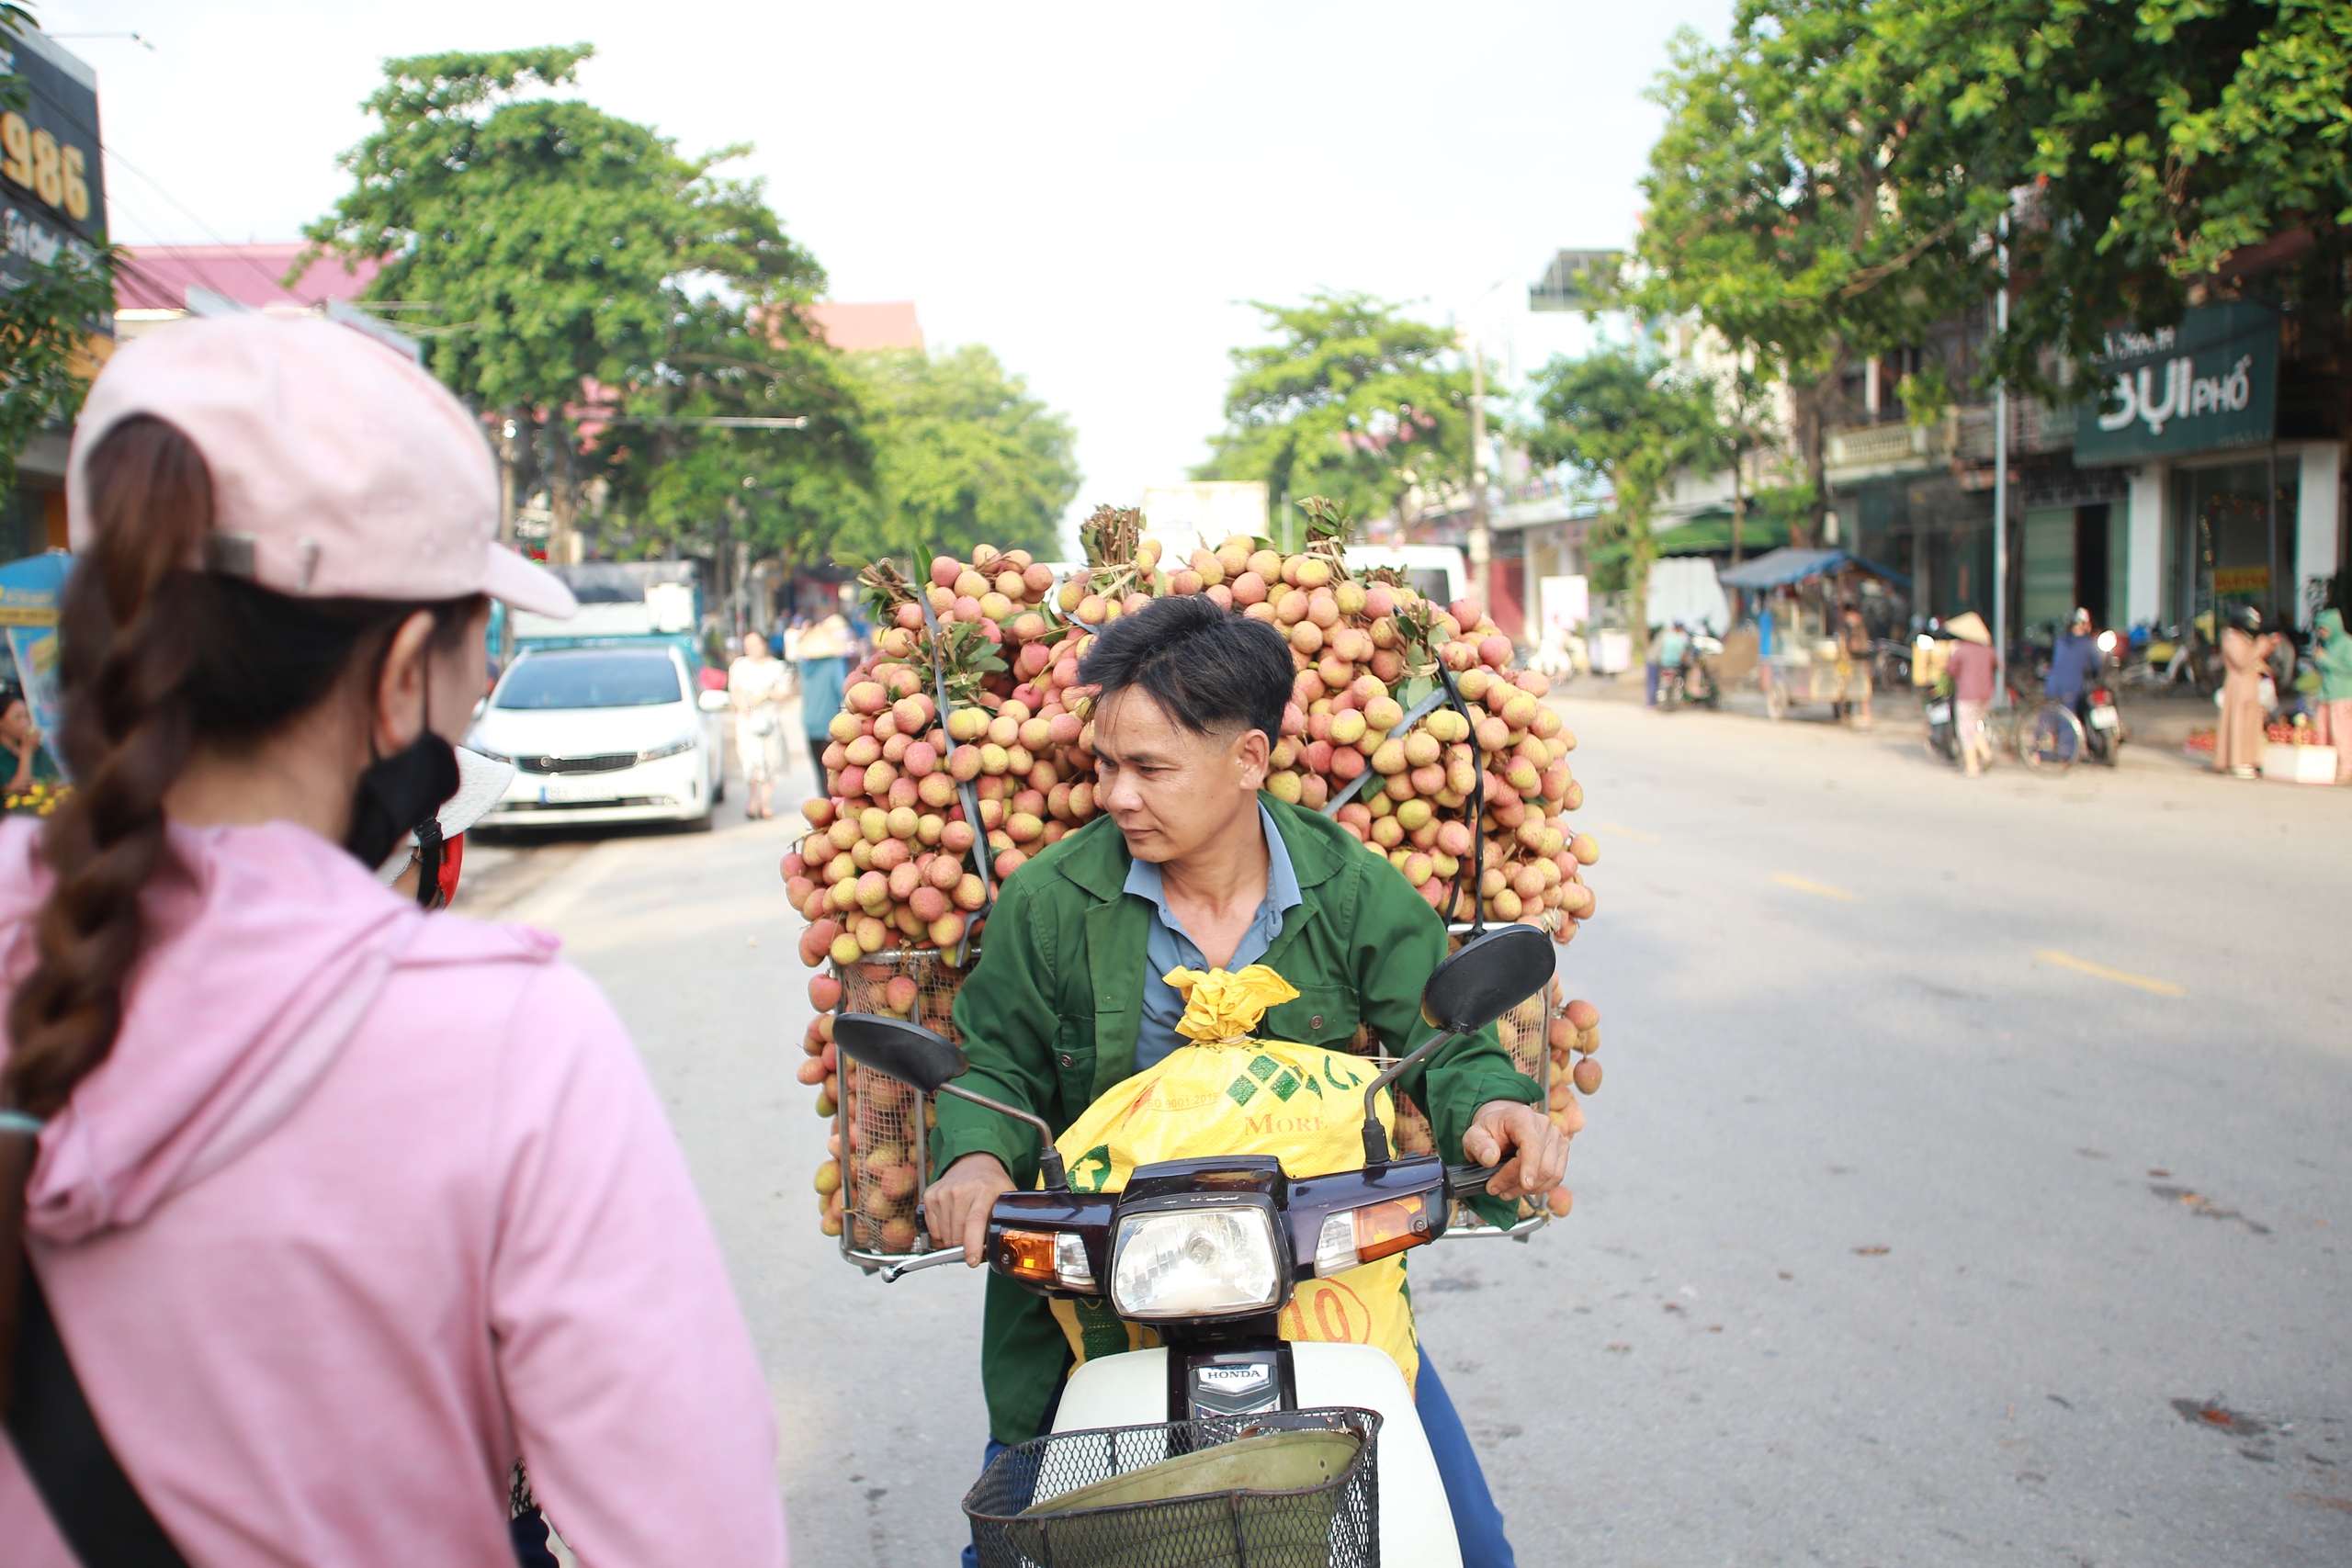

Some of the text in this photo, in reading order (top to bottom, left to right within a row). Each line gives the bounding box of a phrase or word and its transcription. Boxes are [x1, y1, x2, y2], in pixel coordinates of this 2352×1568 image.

[2, 111, 89, 221] 986
[1165, 1092, 1218, 1109] 9001:2015
[1207, 1370, 1262, 1380] HONDA
